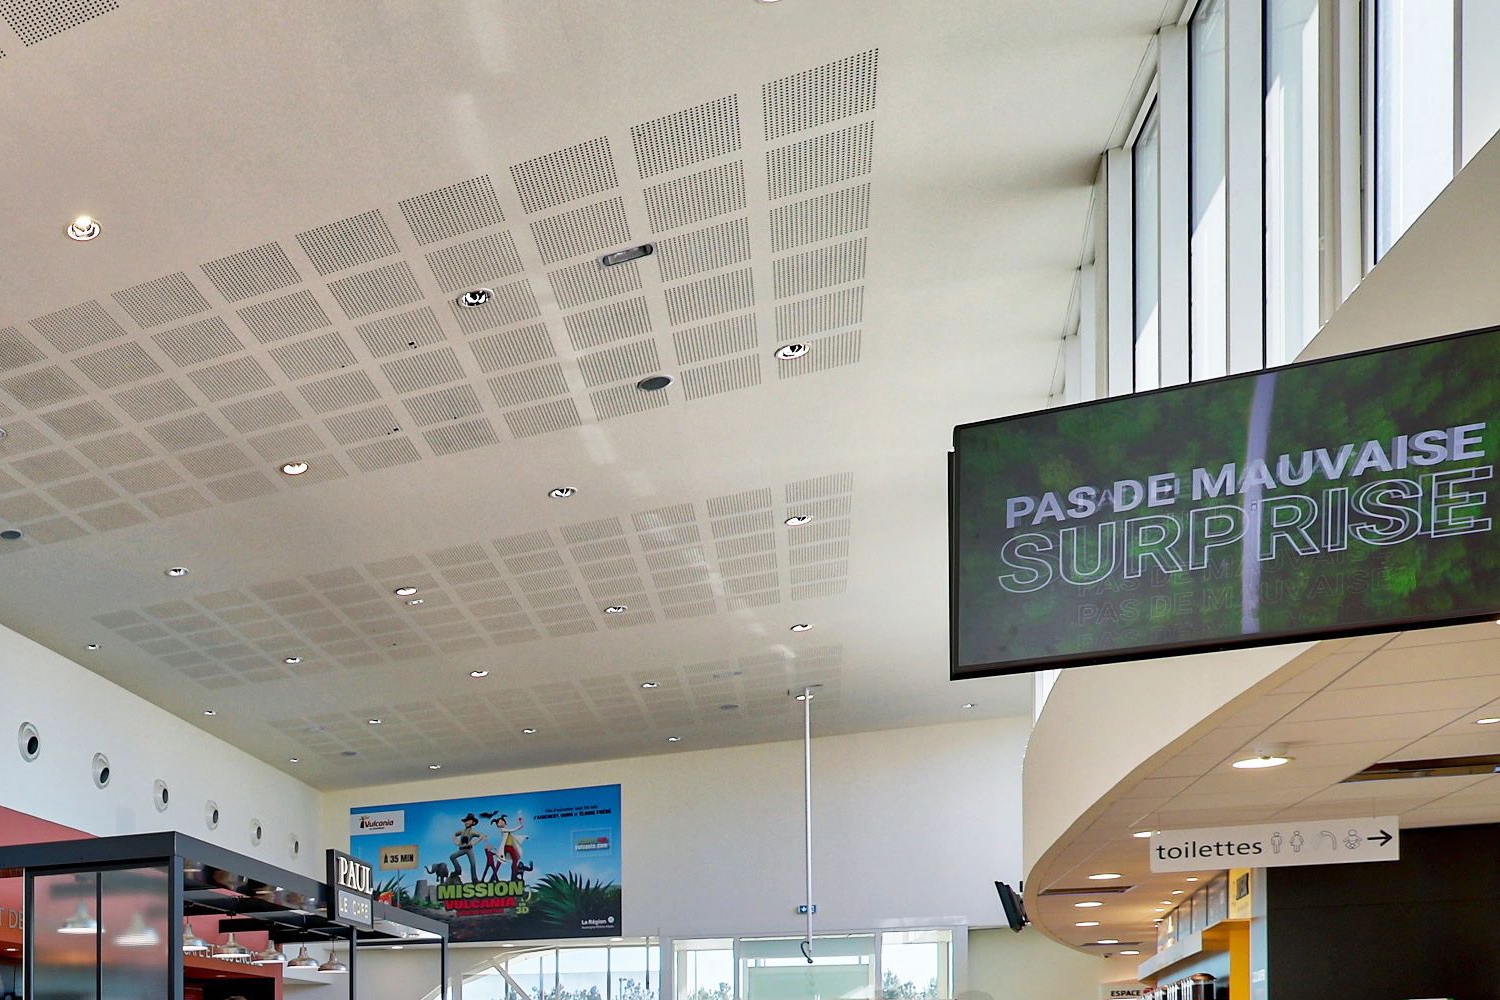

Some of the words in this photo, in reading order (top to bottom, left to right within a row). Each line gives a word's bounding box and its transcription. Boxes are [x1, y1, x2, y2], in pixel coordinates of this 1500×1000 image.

[1006, 486, 1102, 529] PAS
[1113, 473, 1176, 513] DE
[1191, 423, 1486, 501] MAUVAISE
[999, 465, 1493, 593] SURPRISE
[364, 819, 394, 828] Vulcania
[390, 855, 399, 863] 35
[400, 854, 414, 862] MIN
[1156, 841, 1263, 860] toilettes
[337, 856, 373, 895] PAUL
[438, 880, 523, 899] MISSION
[445, 897, 516, 910] VULCANIA
[515, 906, 529, 915] 3D
[589, 918, 607, 926] Région
